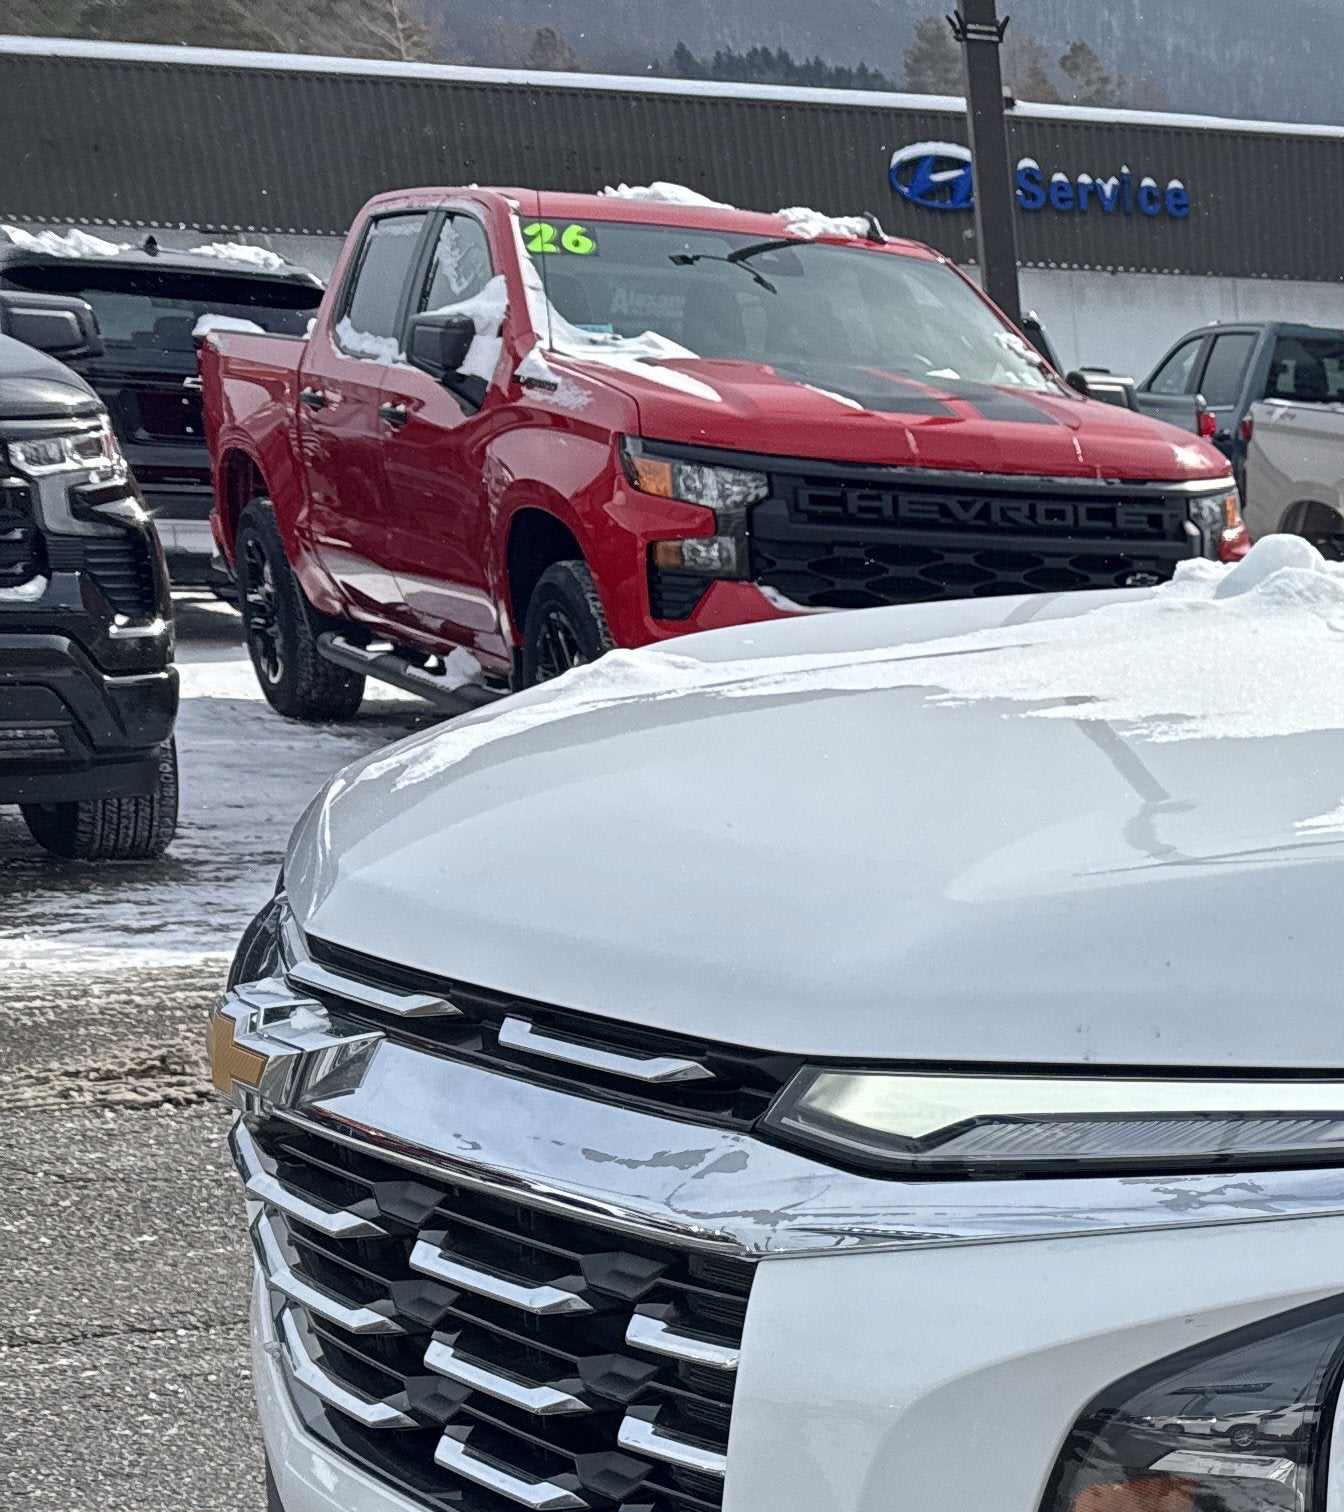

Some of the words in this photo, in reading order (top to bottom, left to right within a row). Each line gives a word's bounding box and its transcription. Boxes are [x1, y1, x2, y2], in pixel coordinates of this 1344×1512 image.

[1015, 158, 1190, 217] Service
[523, 222, 596, 255] 26
[796, 489, 1185, 532] CHEVROLET
